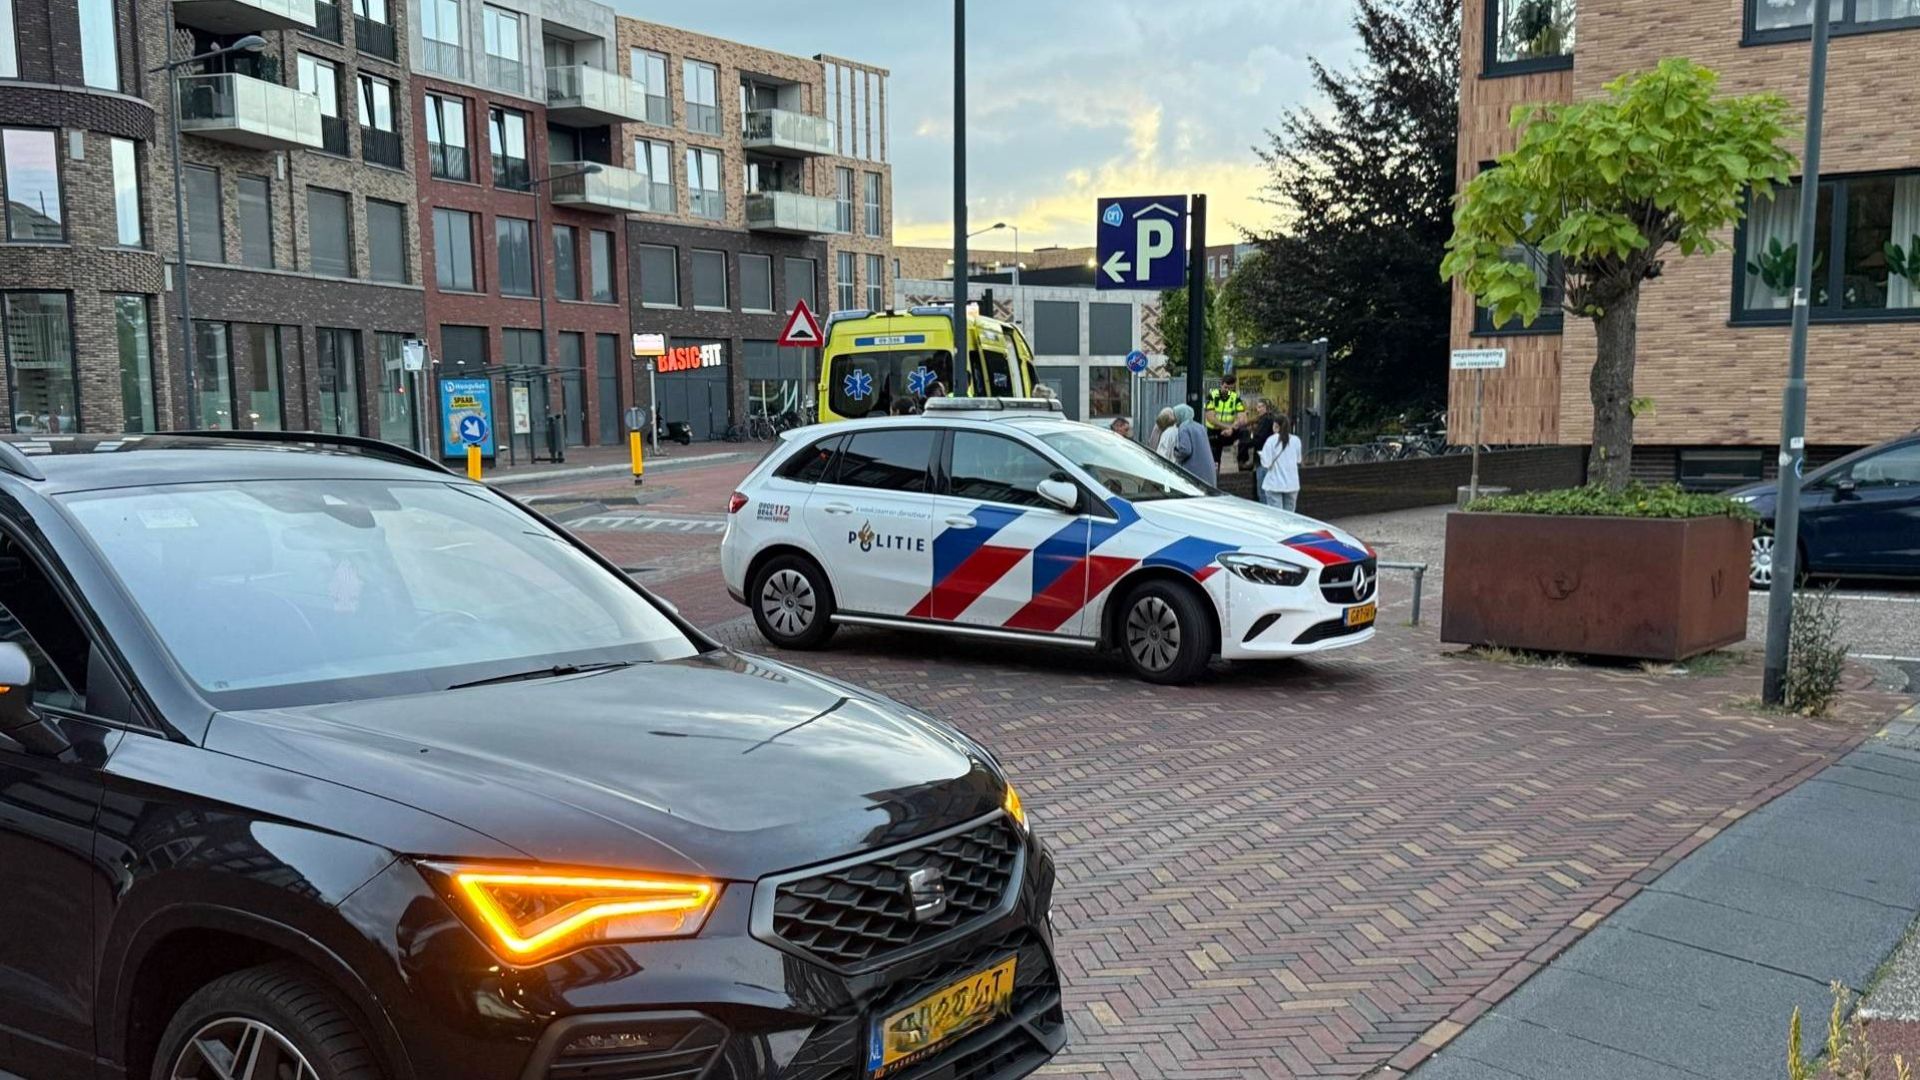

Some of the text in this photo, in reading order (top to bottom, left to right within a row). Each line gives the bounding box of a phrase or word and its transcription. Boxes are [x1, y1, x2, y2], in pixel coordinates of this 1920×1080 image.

[1136, 218, 1174, 281] P
[657, 343, 722, 373] BASIC-FIT
[775, 504, 791, 516] 112
[848, 530, 925, 552] POLITIE
